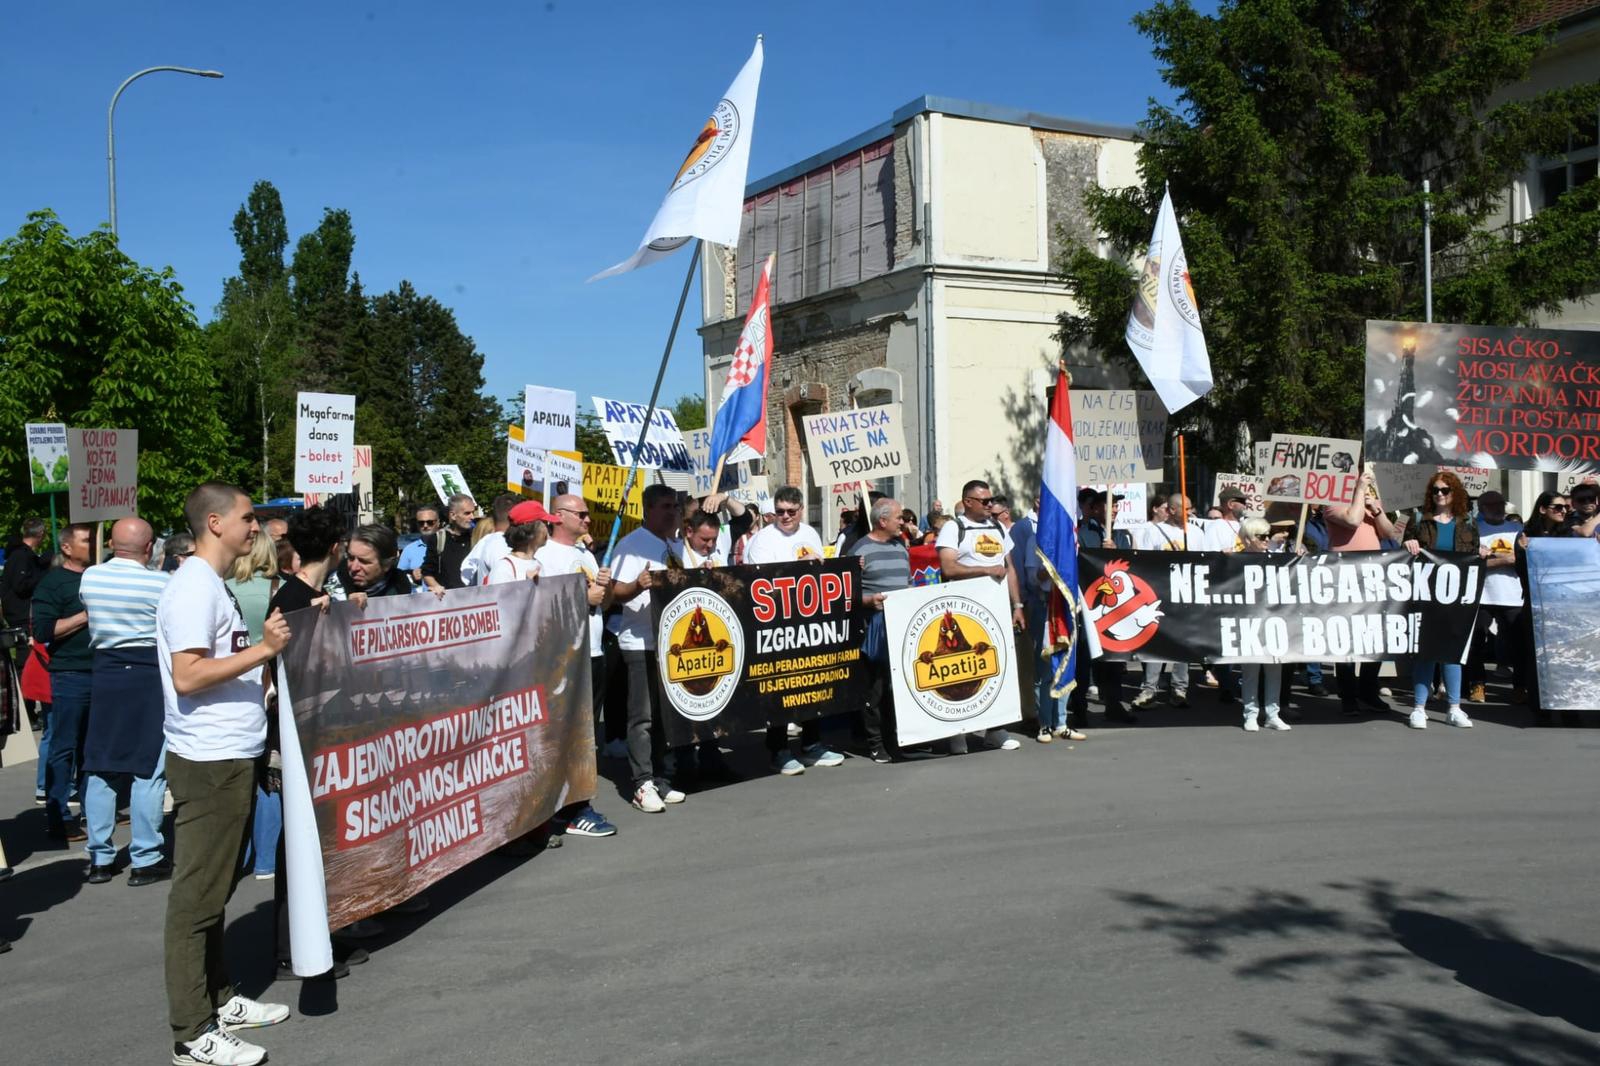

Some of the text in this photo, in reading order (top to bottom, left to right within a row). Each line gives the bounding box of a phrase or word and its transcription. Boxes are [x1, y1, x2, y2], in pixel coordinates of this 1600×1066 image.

[720, 112, 732, 141] FARMI
[1178, 297, 1197, 320] STOP
[1457, 336, 1560, 360] SISAČKO
[1457, 361, 1600, 384] MOSLAVAČK
[1082, 391, 1154, 411] NA ČISTU
[1456, 381, 1569, 408] ŽUPANIJA
[532, 410, 571, 428] APATIJA
[604, 400, 676, 431] APATIJA
[809, 410, 890, 436] HRVATSKA
[1456, 403, 1505, 426] ŽELI
[82, 430, 117, 448] KOLIKO
[308, 427, 339, 441] danas
[821, 428, 888, 458] NIJE NA
[1456, 430, 1600, 461] MORDOR
[87, 448, 117, 466] KOŠTA
[829, 451, 900, 478] PRODAJU
[1096, 445, 1127, 460] MORA
[1271, 442, 1330, 470] FARME
[86, 468, 116, 485] JEDNA
[308, 471, 343, 484] sutra!
[582, 465, 638, 488] APATIA
[1089, 463, 1136, 481] SVAK!
[81, 484, 136, 512] ŽUPANIJA?
[597, 488, 619, 499] NIJE
[756, 490, 768, 501] NA
[1304, 472, 1357, 504] BOLE
[750, 571, 852, 622] STOP!
[664, 605, 681, 630] STOP
[684, 597, 705, 608] FARMI
[910, 612, 928, 638] STOP
[930, 602, 957, 615] FARMI
[351, 610, 501, 657] NE PILIĆARSKOJ EKO BOMBI!
[756, 619, 850, 654] IZGRADNJI
[1219, 615, 1289, 657] EKO
[677, 653, 724, 675] Apatija
[749, 648, 859, 677] MEGA PERADARSKIH FARMI
[928, 655, 987, 682] Apatija
[759, 667, 850, 693] U SJEVEROZAPADNOJ
[675, 688, 688, 705] SELO
[716, 683, 728, 702] KOKA
[782, 687, 833, 708] HRVATSKOJ!
[926, 697, 943, 712] SELO
[979, 685, 995, 704] KOKA
[312, 690, 543, 799] ZAJEDNO PROTIV UNIŠTENJA
[343, 737, 524, 841] SISAČKO-MOSLAVAČKE
[407, 799, 479, 867] ŽUPANIJE
